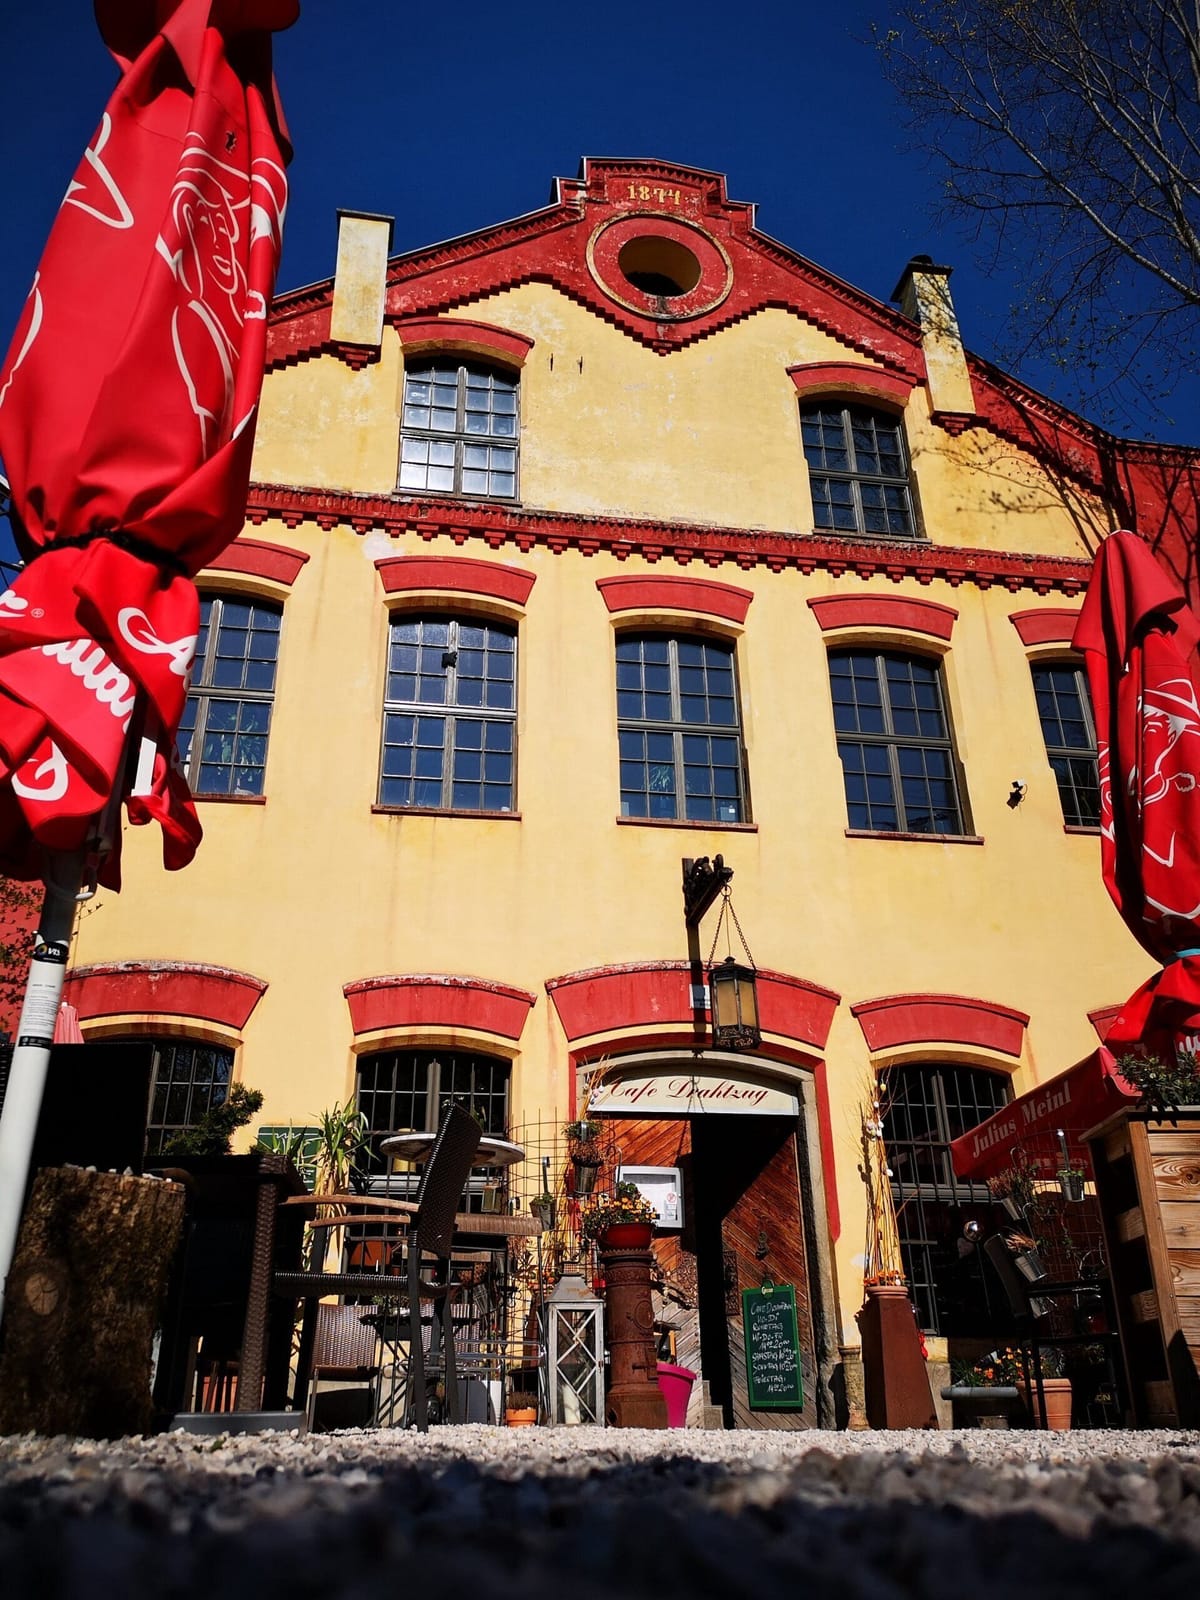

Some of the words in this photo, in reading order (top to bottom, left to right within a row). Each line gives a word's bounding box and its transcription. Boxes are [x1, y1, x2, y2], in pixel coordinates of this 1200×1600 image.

[628, 184, 681, 206] 1874
[608, 1078, 658, 1104] Cafe
[667, 1078, 769, 1106] Drahtzug
[973, 1119, 1017, 1158] Julius
[1021, 1080, 1072, 1126] Meinl
